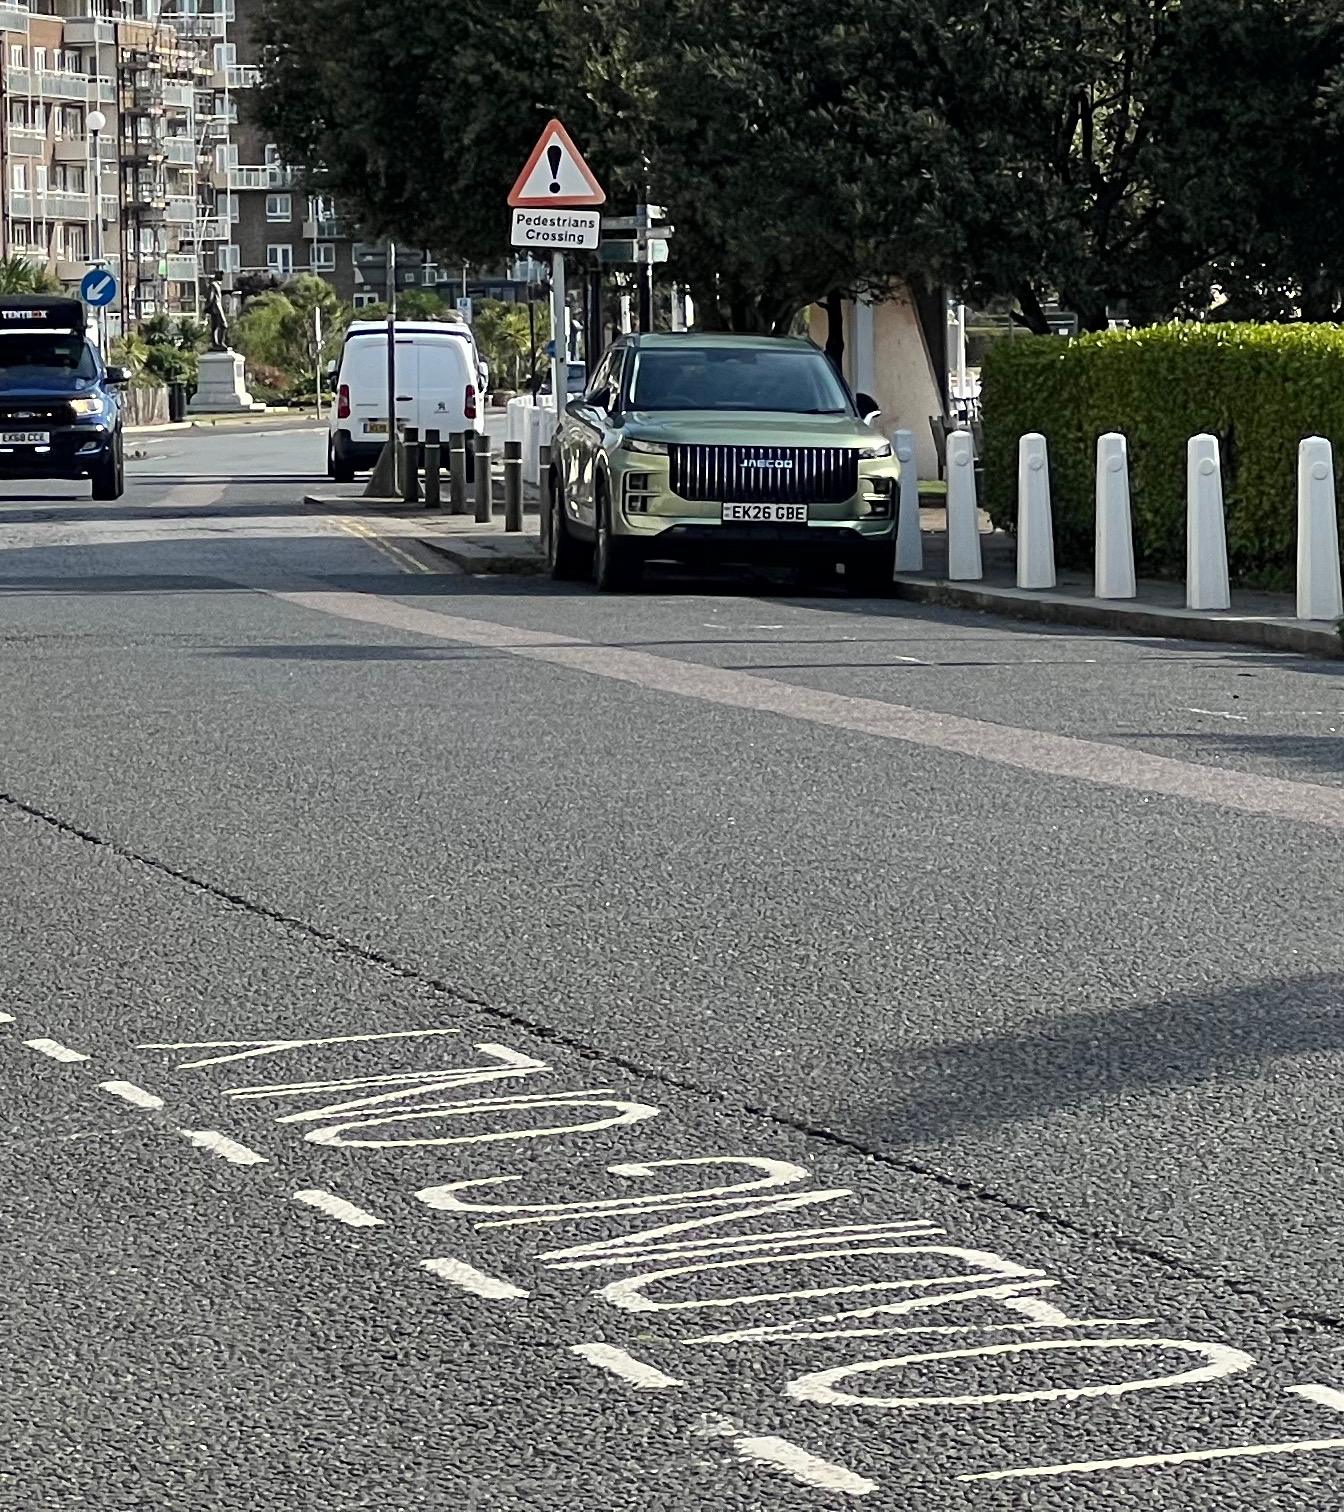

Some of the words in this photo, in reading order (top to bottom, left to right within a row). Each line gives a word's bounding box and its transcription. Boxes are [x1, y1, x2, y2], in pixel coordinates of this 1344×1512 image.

[516, 214, 595, 228] Pedestrians
[525, 229, 585, 245] Crossing
[1, 310, 48, 319] TENTBOX
[739, 459, 792, 468] JAECOO
[732, 505, 771, 519] EK26
[776, 506, 805, 520] GBE
[136, 1029, 658, 1149] ONLY
